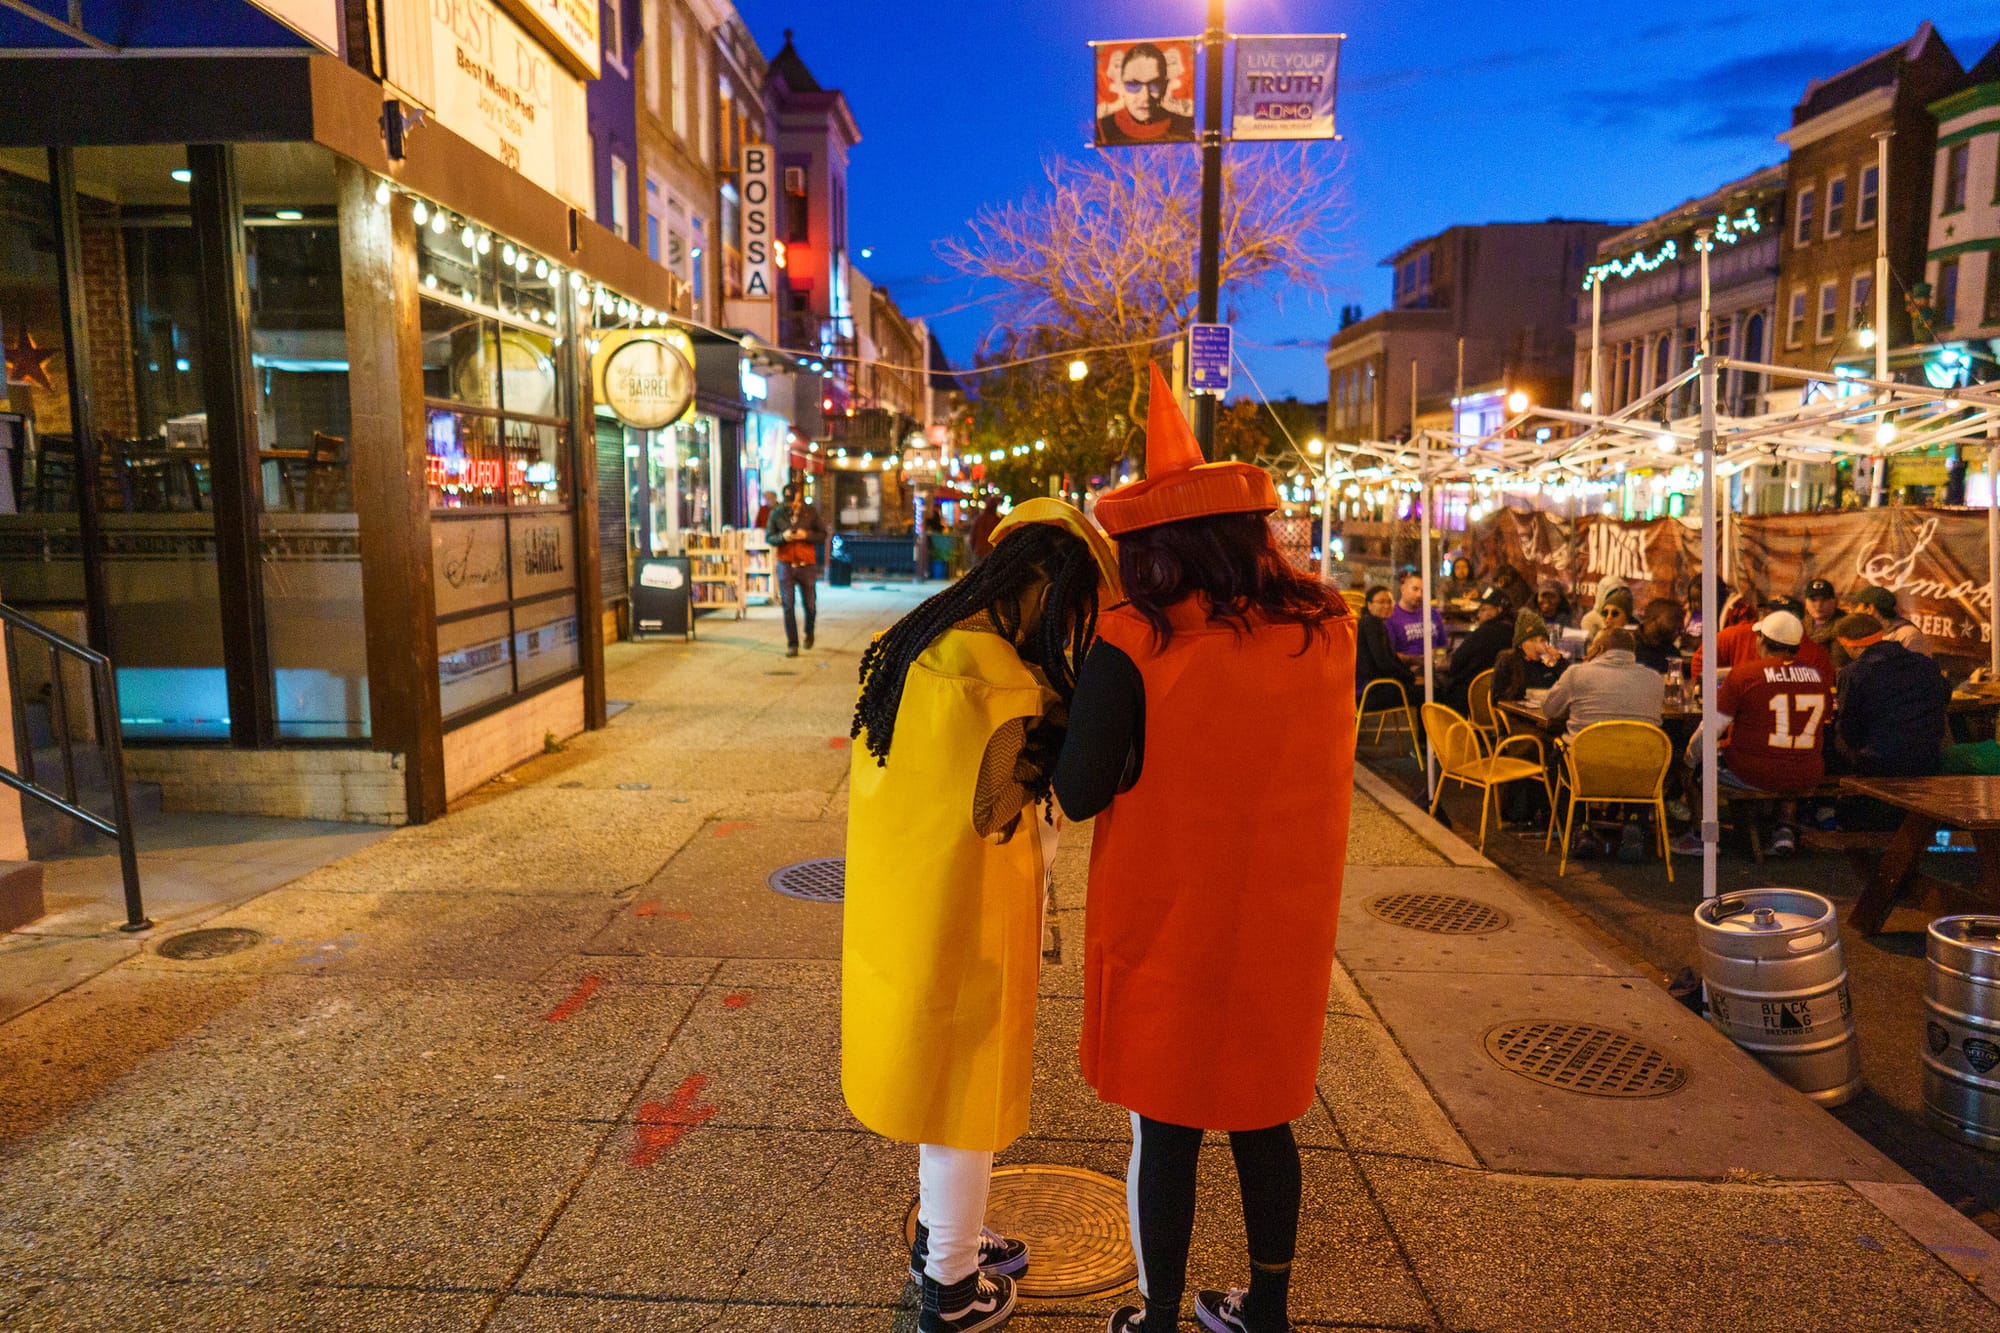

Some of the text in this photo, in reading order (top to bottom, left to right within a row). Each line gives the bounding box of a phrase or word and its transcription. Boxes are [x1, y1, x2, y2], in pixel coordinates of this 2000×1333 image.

[456, 45, 482, 83] Best
[1247, 54, 1325, 69] LIVE YOUR
[1247, 72, 1323, 93] TRUTH
[1255, 103, 1312, 120] ADMO
[746, 150, 768, 294] BOSSA
[628, 378, 671, 398] BARREL
[1910, 613, 1956, 638] BEER
[1763, 666, 1821, 683] McLAURIN
[1768, 694, 1825, 749] 17
